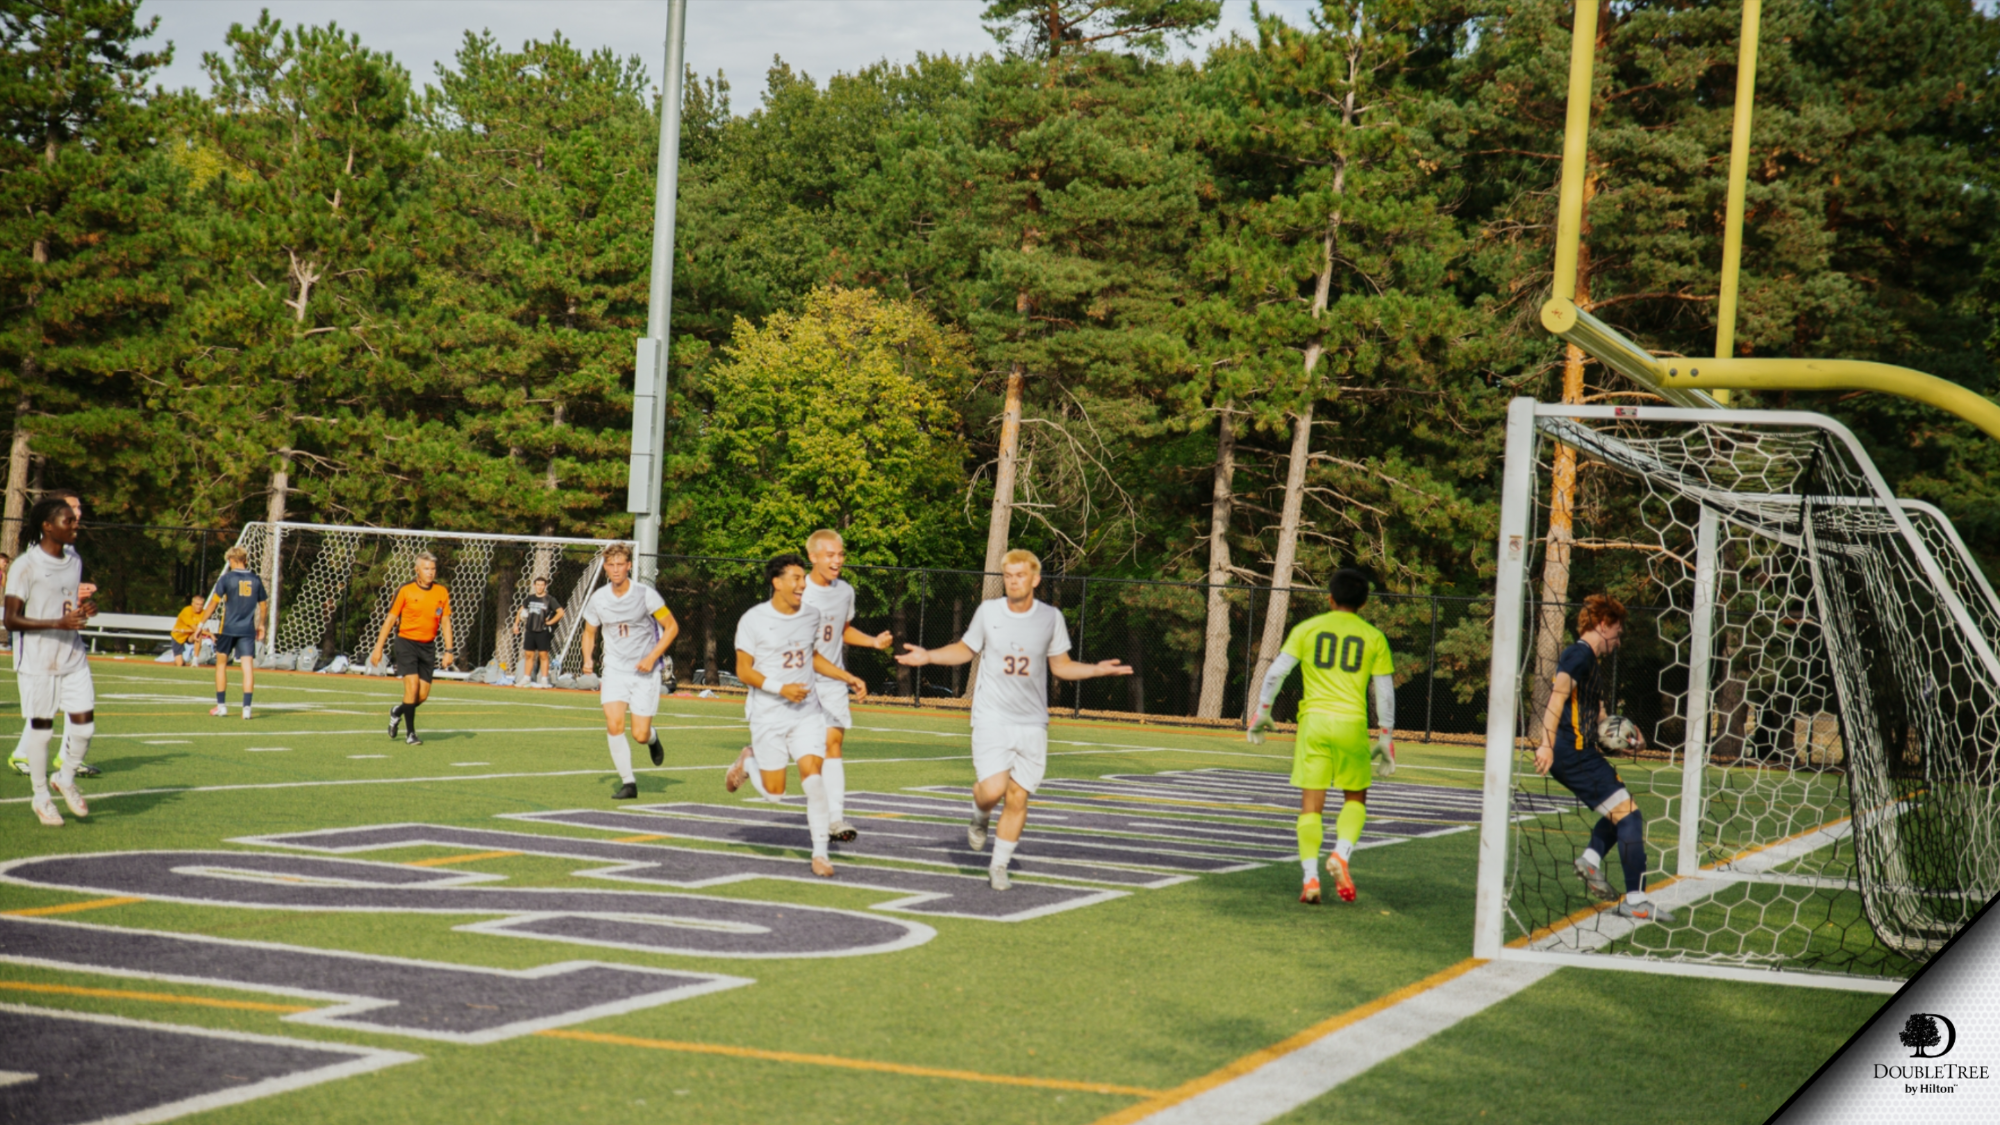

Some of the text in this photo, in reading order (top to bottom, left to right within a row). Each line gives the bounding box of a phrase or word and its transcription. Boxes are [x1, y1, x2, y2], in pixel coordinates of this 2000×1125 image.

[239, 580, 252, 597] 16
[618, 622, 629, 638] 11
[823, 624, 833, 643] 8
[782, 650, 805, 670] 23
[1314, 631, 1365, 674] 00
[1003, 655, 1030, 677] 32
